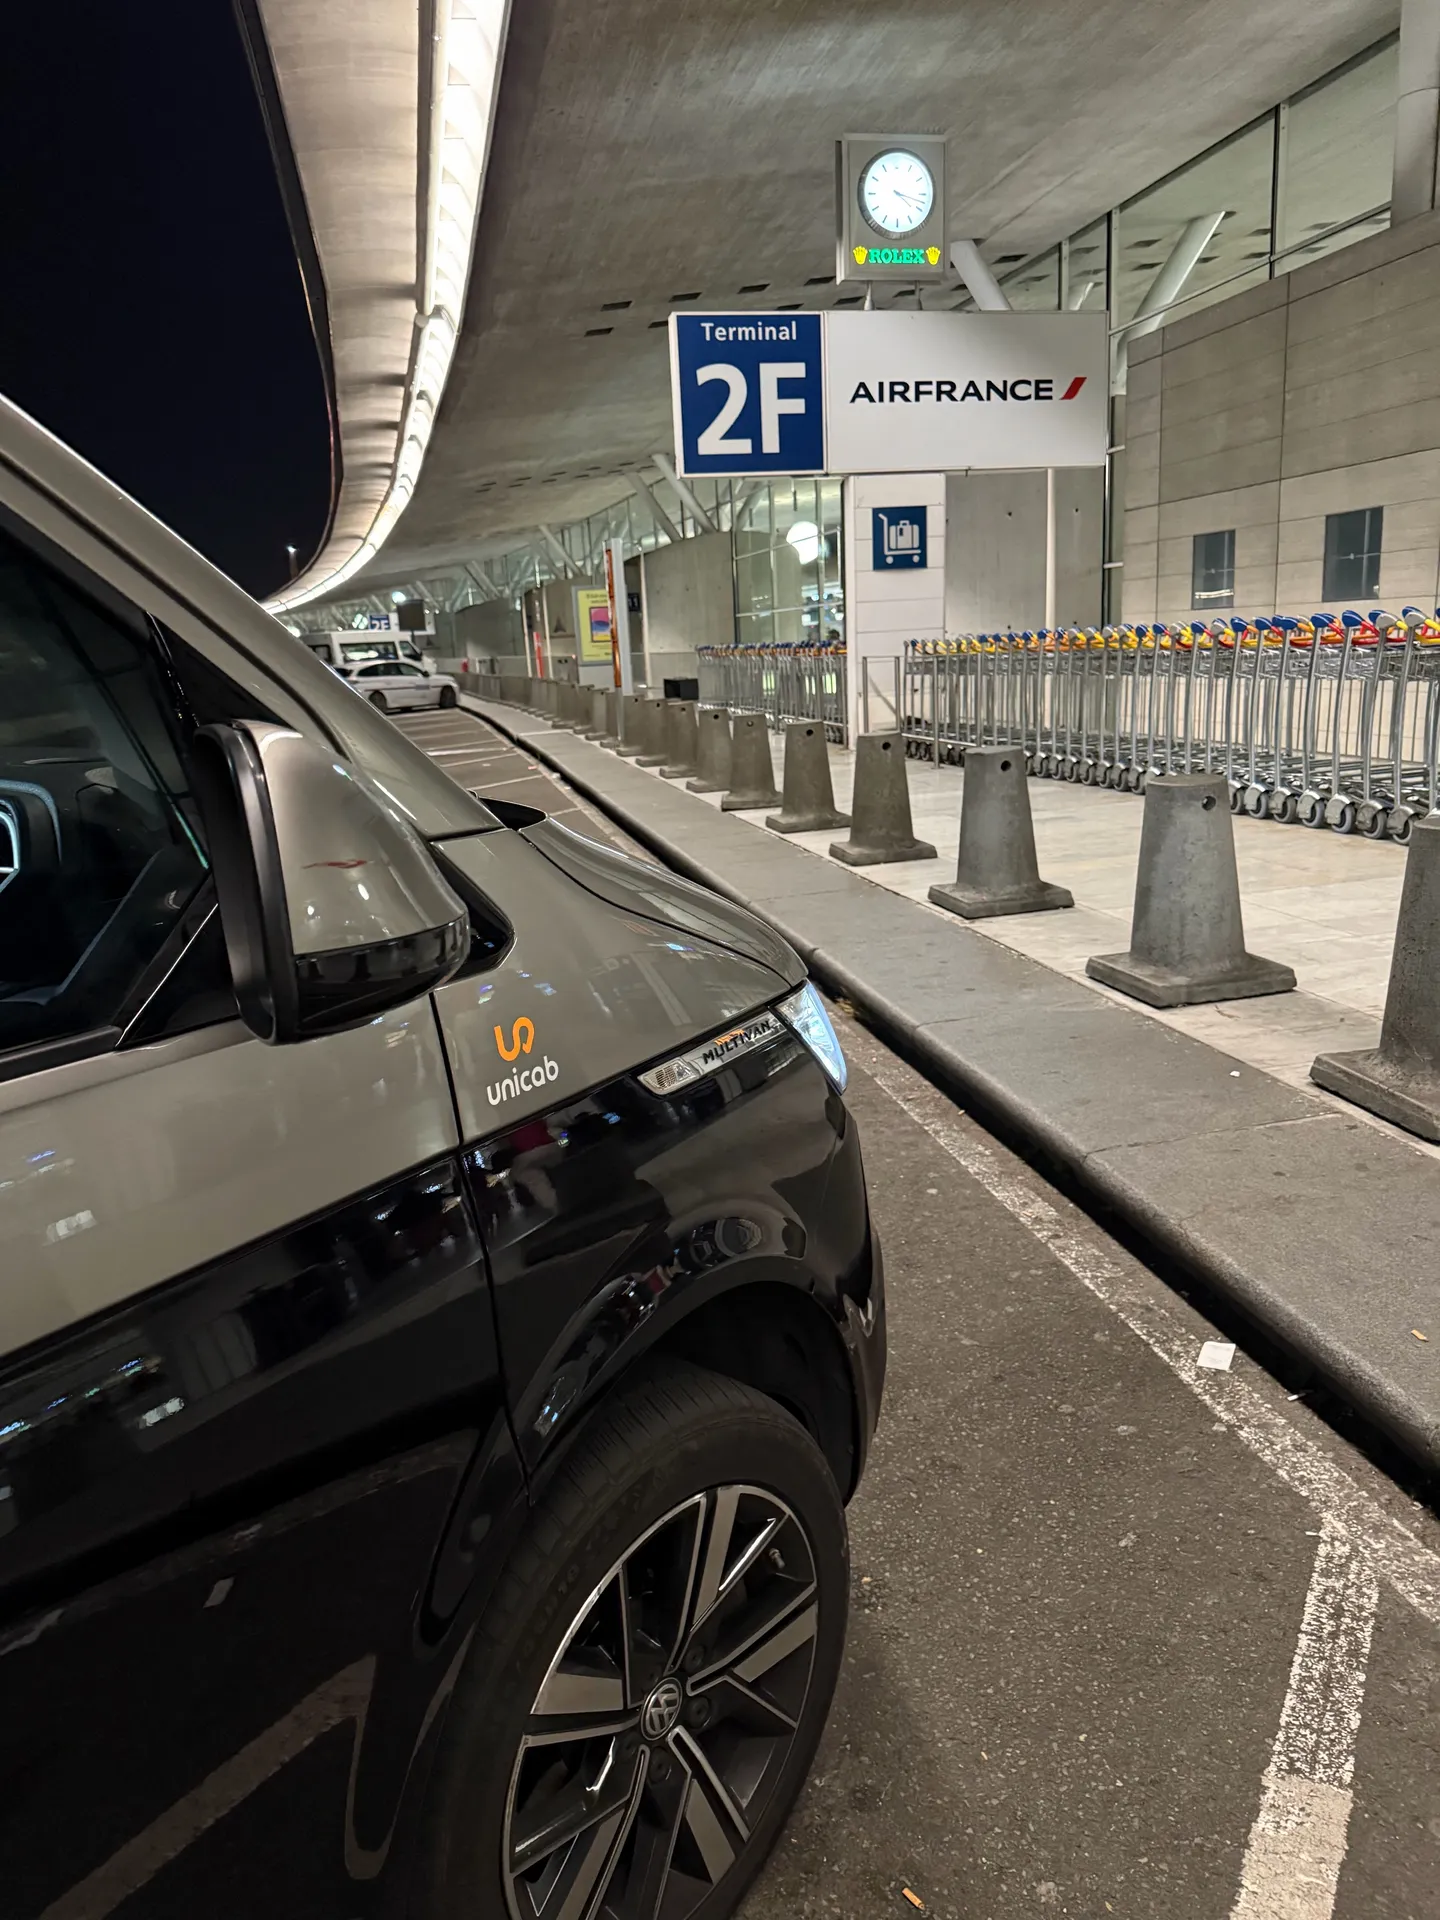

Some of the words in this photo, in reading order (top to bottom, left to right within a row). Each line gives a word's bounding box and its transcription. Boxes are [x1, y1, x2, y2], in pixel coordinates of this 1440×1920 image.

[868, 248, 926, 264] ROLEX
[700, 320, 797, 341] Terminal
[849, 379, 1053, 403] AIRFRANCE
[695, 362, 806, 456] 2F
[702, 1019, 771, 1065] MULTIVAN
[486, 1055, 559, 1106] unicab
